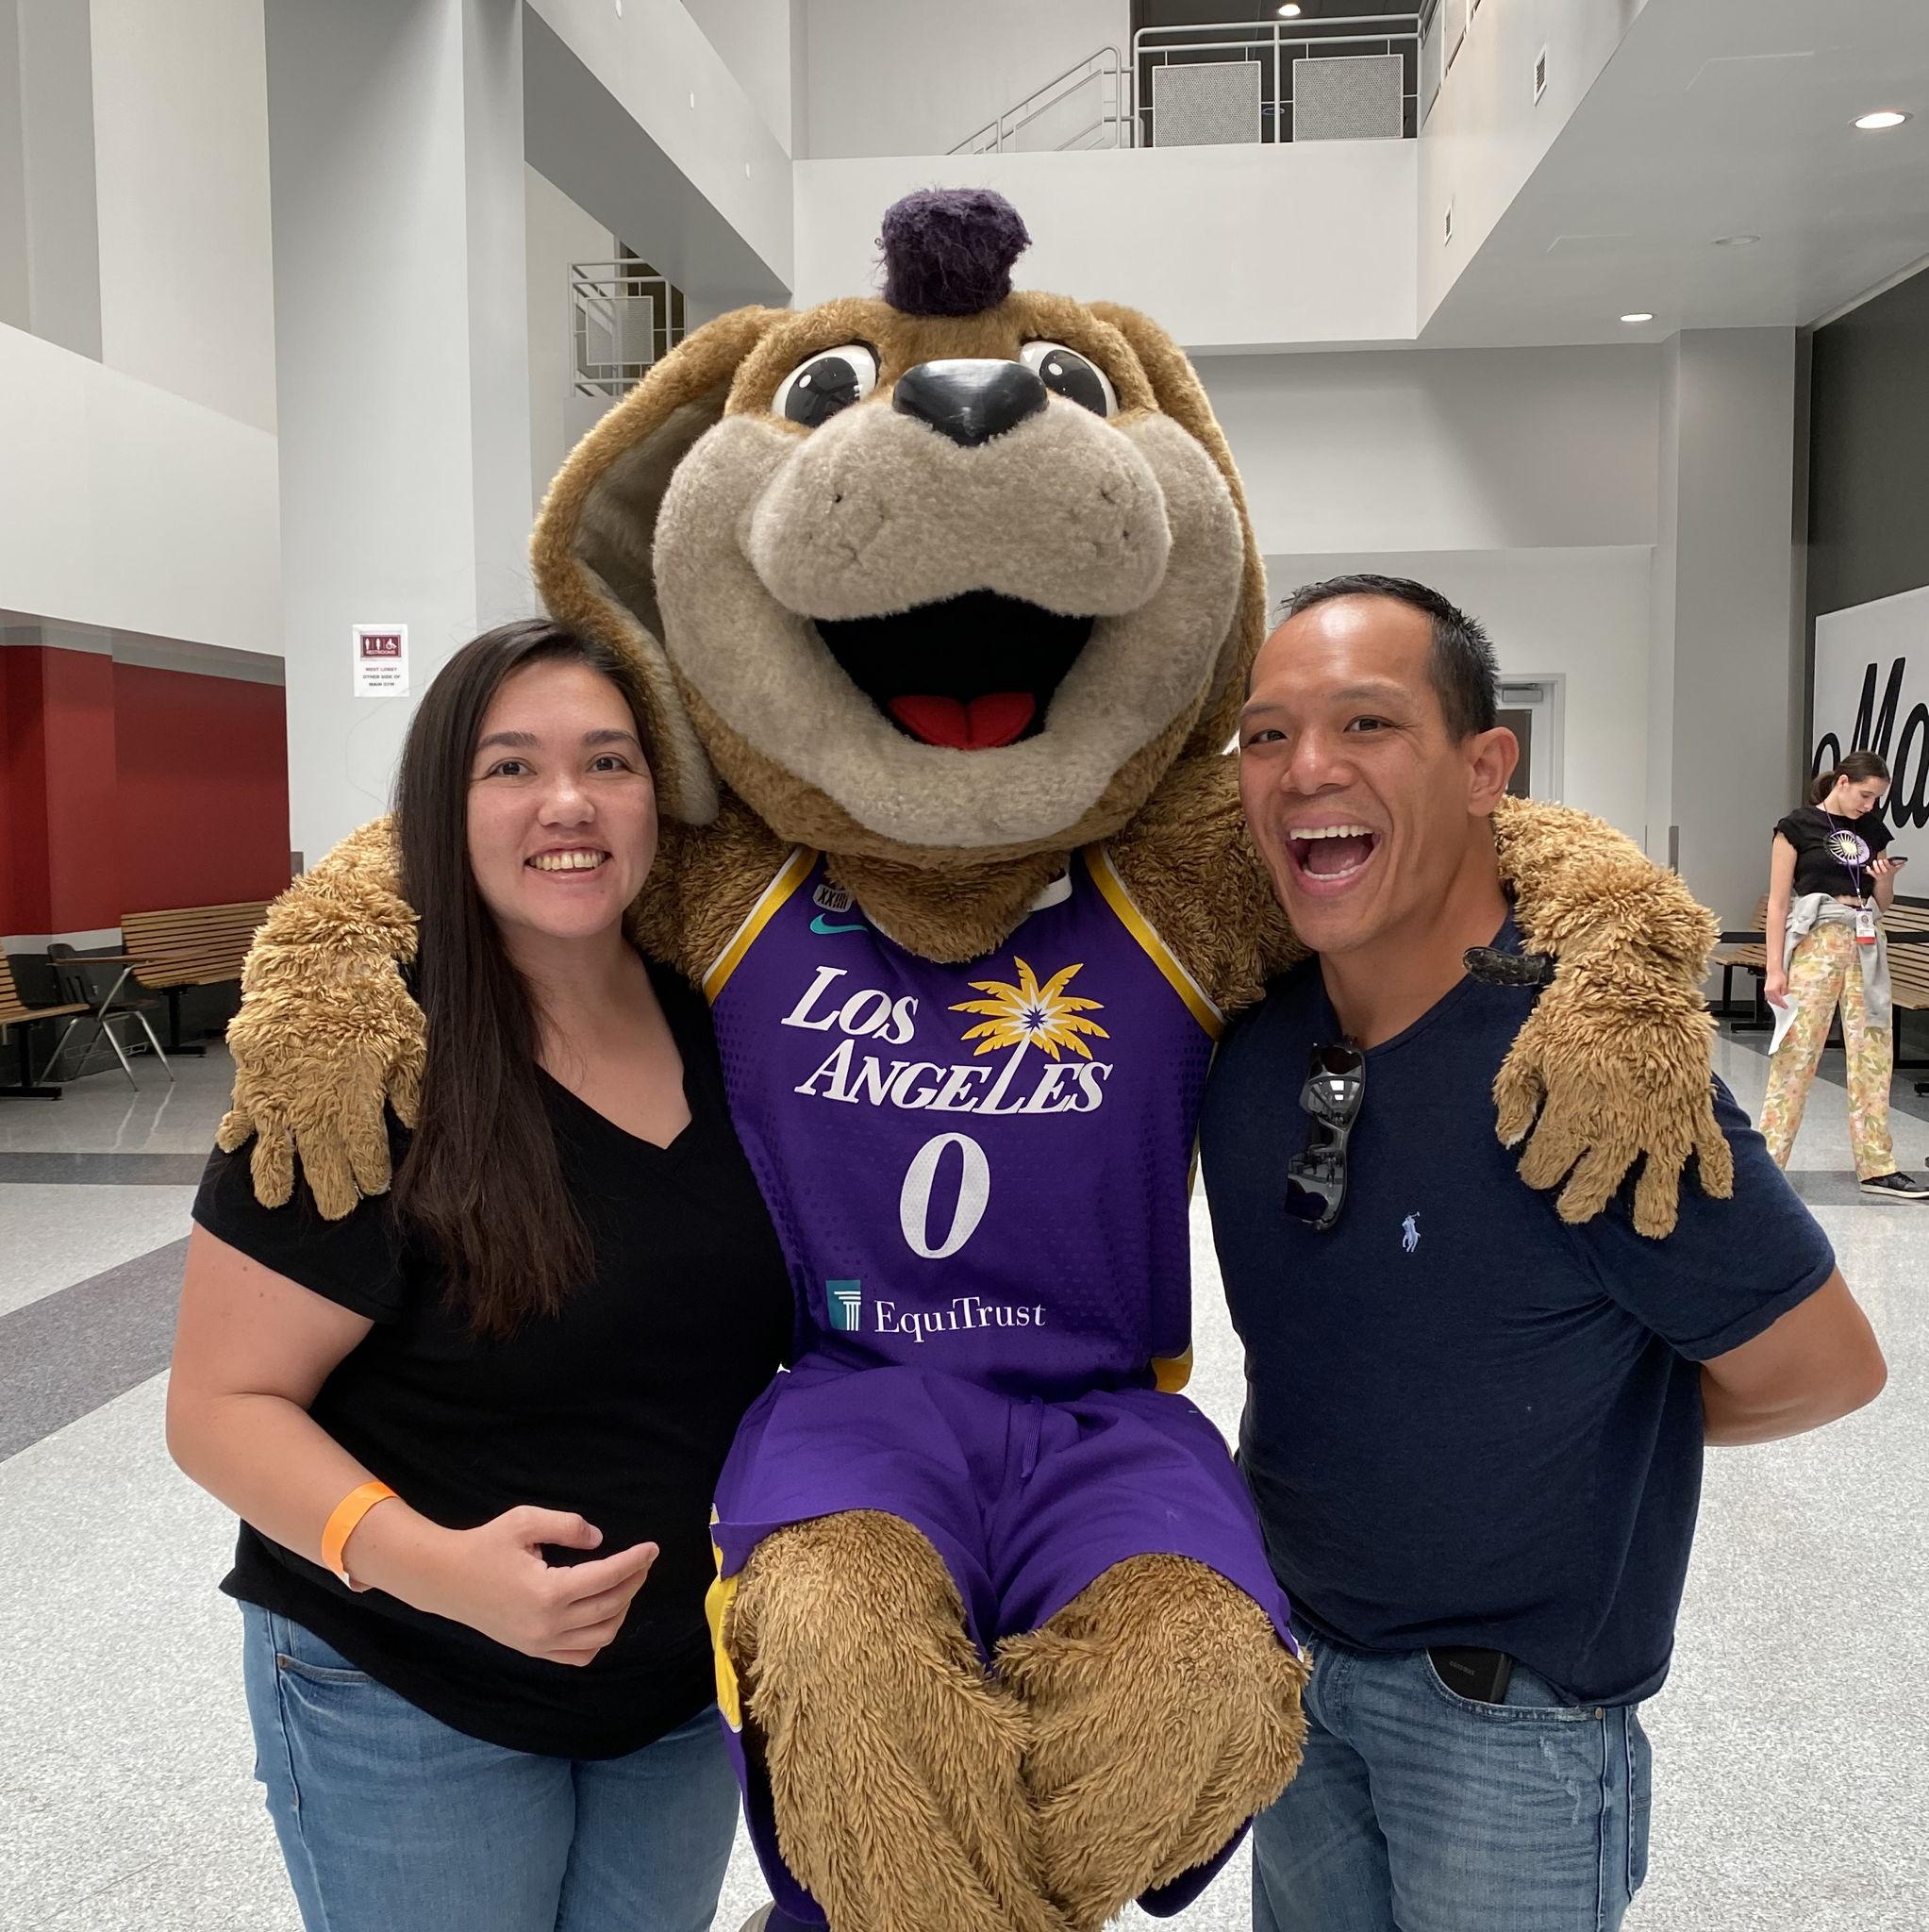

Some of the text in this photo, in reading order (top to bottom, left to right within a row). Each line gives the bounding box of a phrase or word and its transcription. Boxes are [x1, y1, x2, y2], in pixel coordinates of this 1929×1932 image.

[780, 965, 919, 1044] LOS
[794, 1032, 1113, 1114] ANGELES
[899, 1132, 990, 1259] 0
[873, 1296, 1047, 1343] EquiTrust
